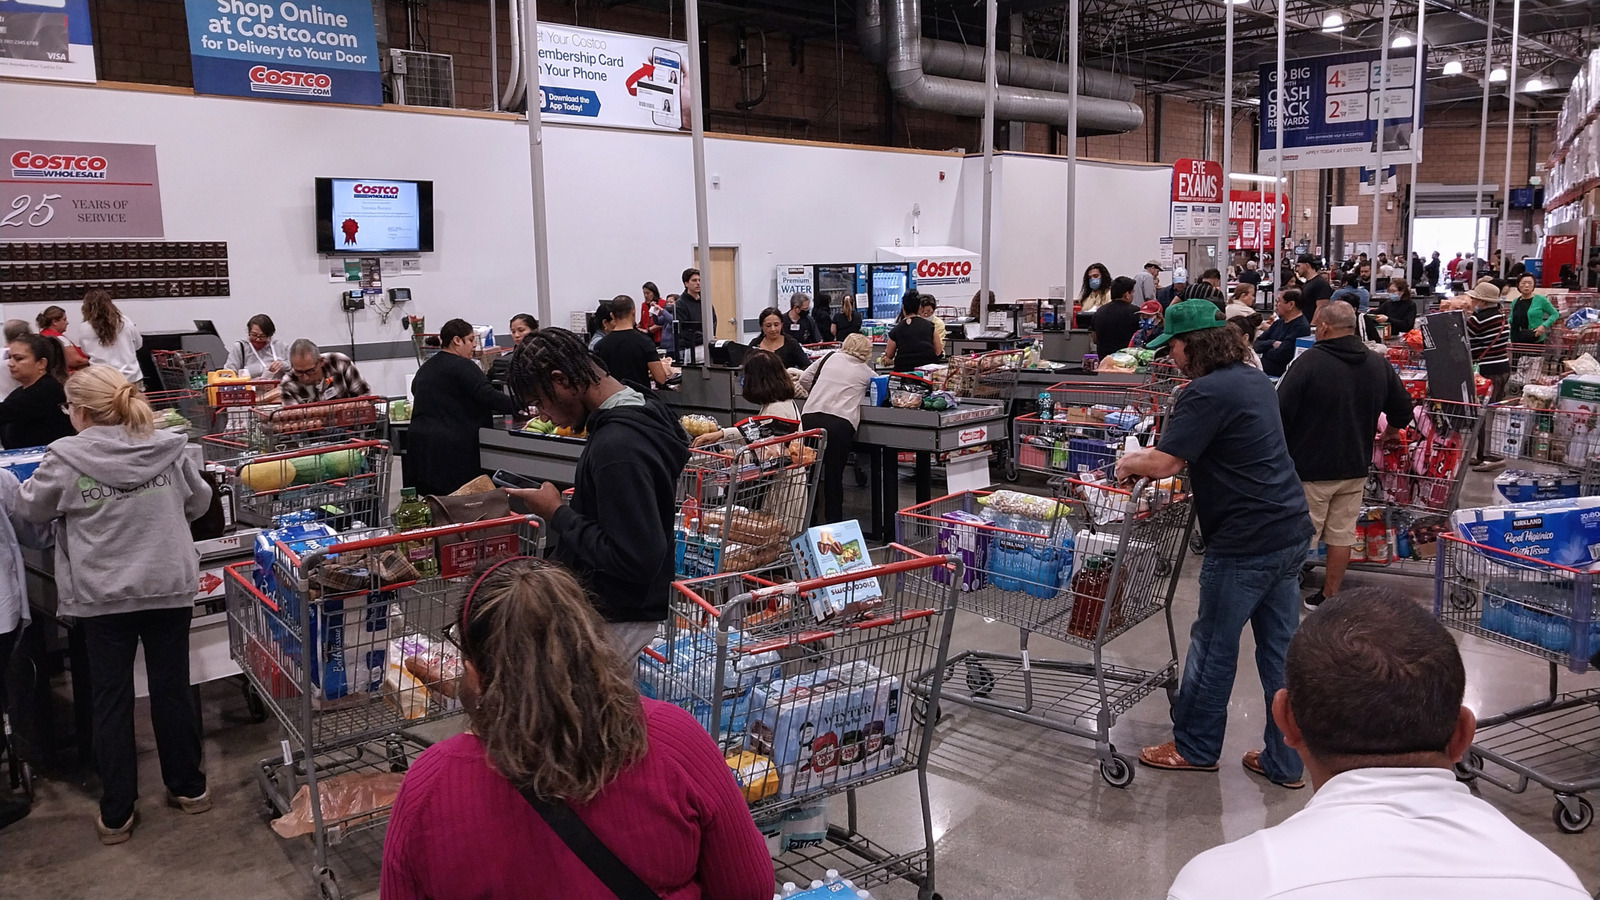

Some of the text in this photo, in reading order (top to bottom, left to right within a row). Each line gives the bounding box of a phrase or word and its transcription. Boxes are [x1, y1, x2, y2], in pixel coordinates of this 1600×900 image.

[217, 0, 348, 28] Shop Online
[208, 17, 358, 48] at Costco.com
[547, 31, 568, 45] Your
[572, 34, 607, 50] Costco
[201, 35, 368, 64] for Delivery to Your Door
[538, 48, 624, 68] embership Card
[544, 63, 570, 76] Your
[573, 66, 607, 81] Phone
[1290, 67, 1310, 80] BIG
[549, 93, 579, 102] Download
[1268, 86, 1310, 103] CASH
[550, 102, 583, 112] App Today!
[1268, 101, 1310, 118] BACK
[1192, 161, 1206, 174] EYE
[1179, 173, 1217, 198] EXAMS
[0, 194, 62, 227] 25
[72, 200, 128, 209] YEARS OF
[1229, 201, 1286, 220] MEMBESHP
[78, 213, 127, 223] SERVICE
[781, 285, 812, 293] WATER
[1504, 532, 1524, 543] Papel
[1528, 546, 1550, 556] Tissue
